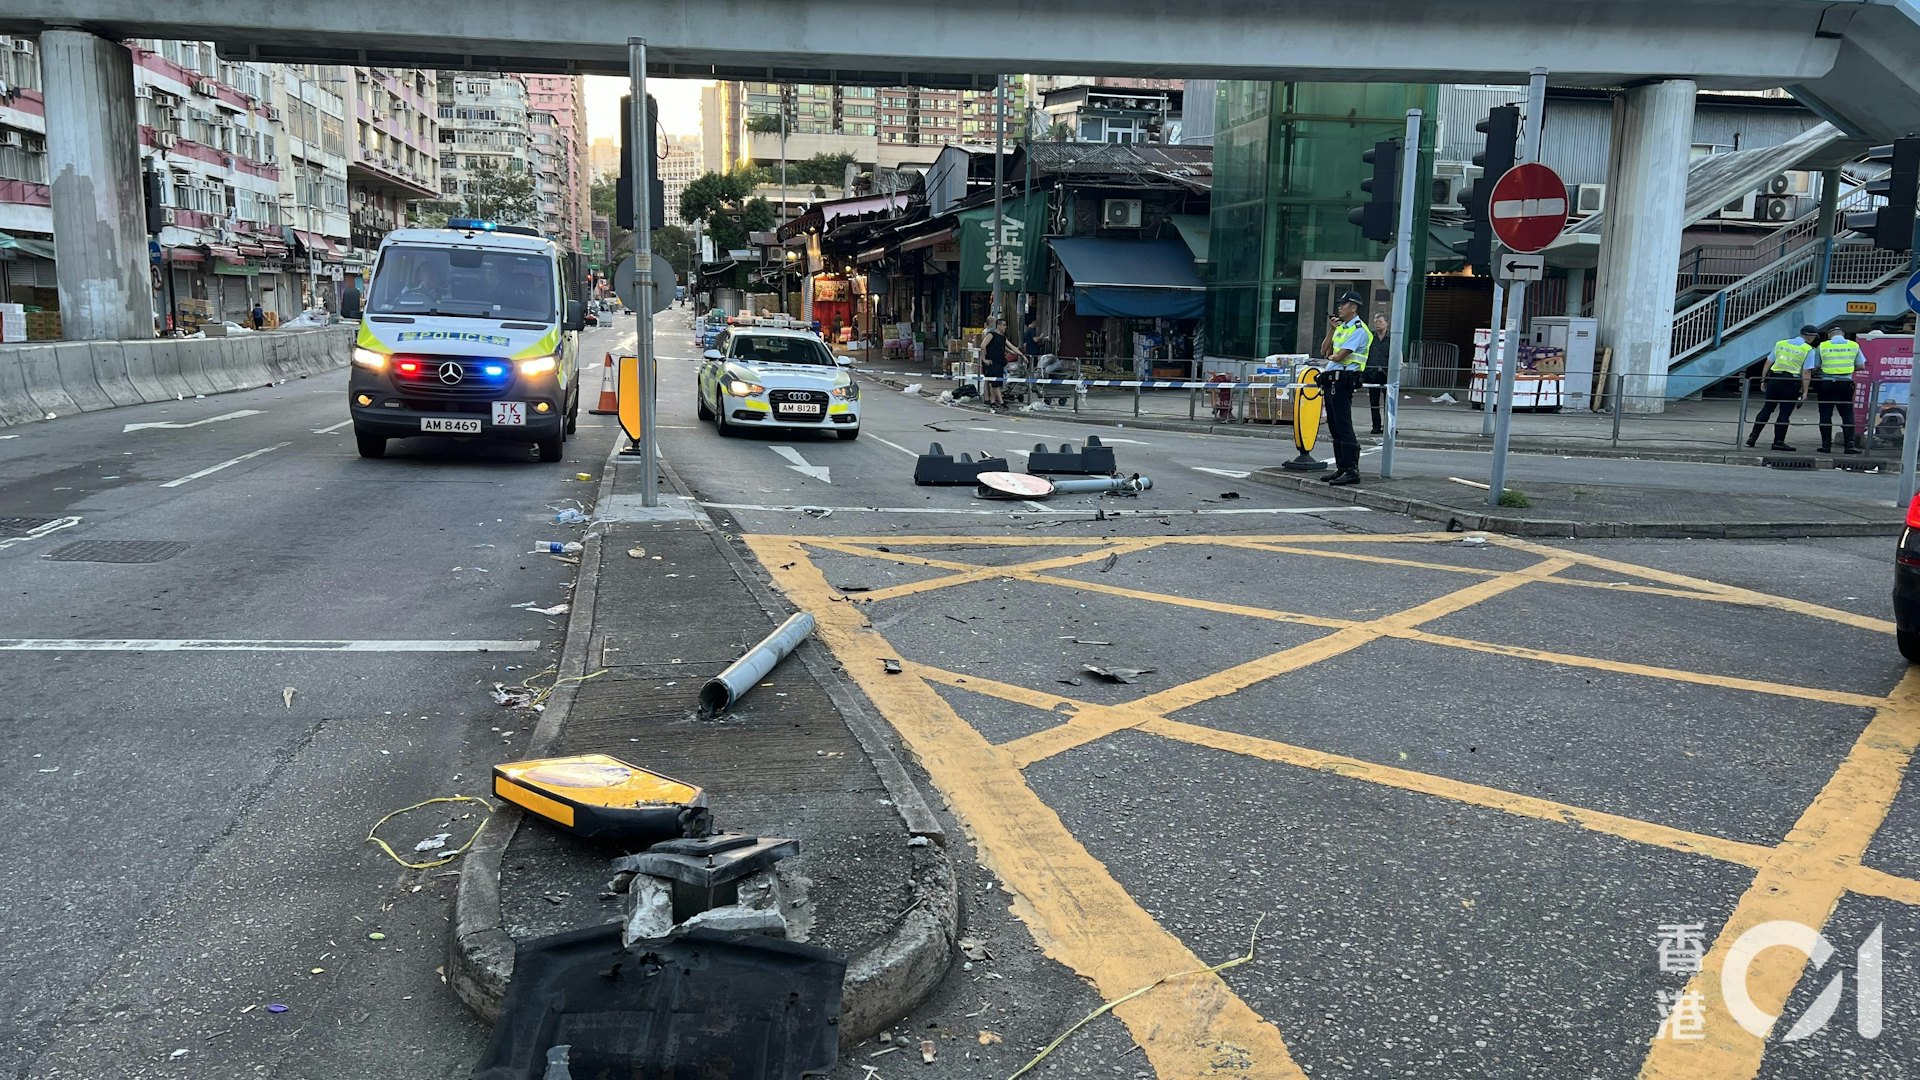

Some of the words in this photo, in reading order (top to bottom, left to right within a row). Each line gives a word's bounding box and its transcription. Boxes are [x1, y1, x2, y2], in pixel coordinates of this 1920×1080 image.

[420, 332, 488, 342] POLICE
[500, 403, 518, 414] TK
[782, 403, 794, 412] AM
[796, 404, 818, 413] 8128
[497, 414, 521, 425] 2/3
[425, 420, 441, 430] AM
[444, 420, 478, 431] 8469
